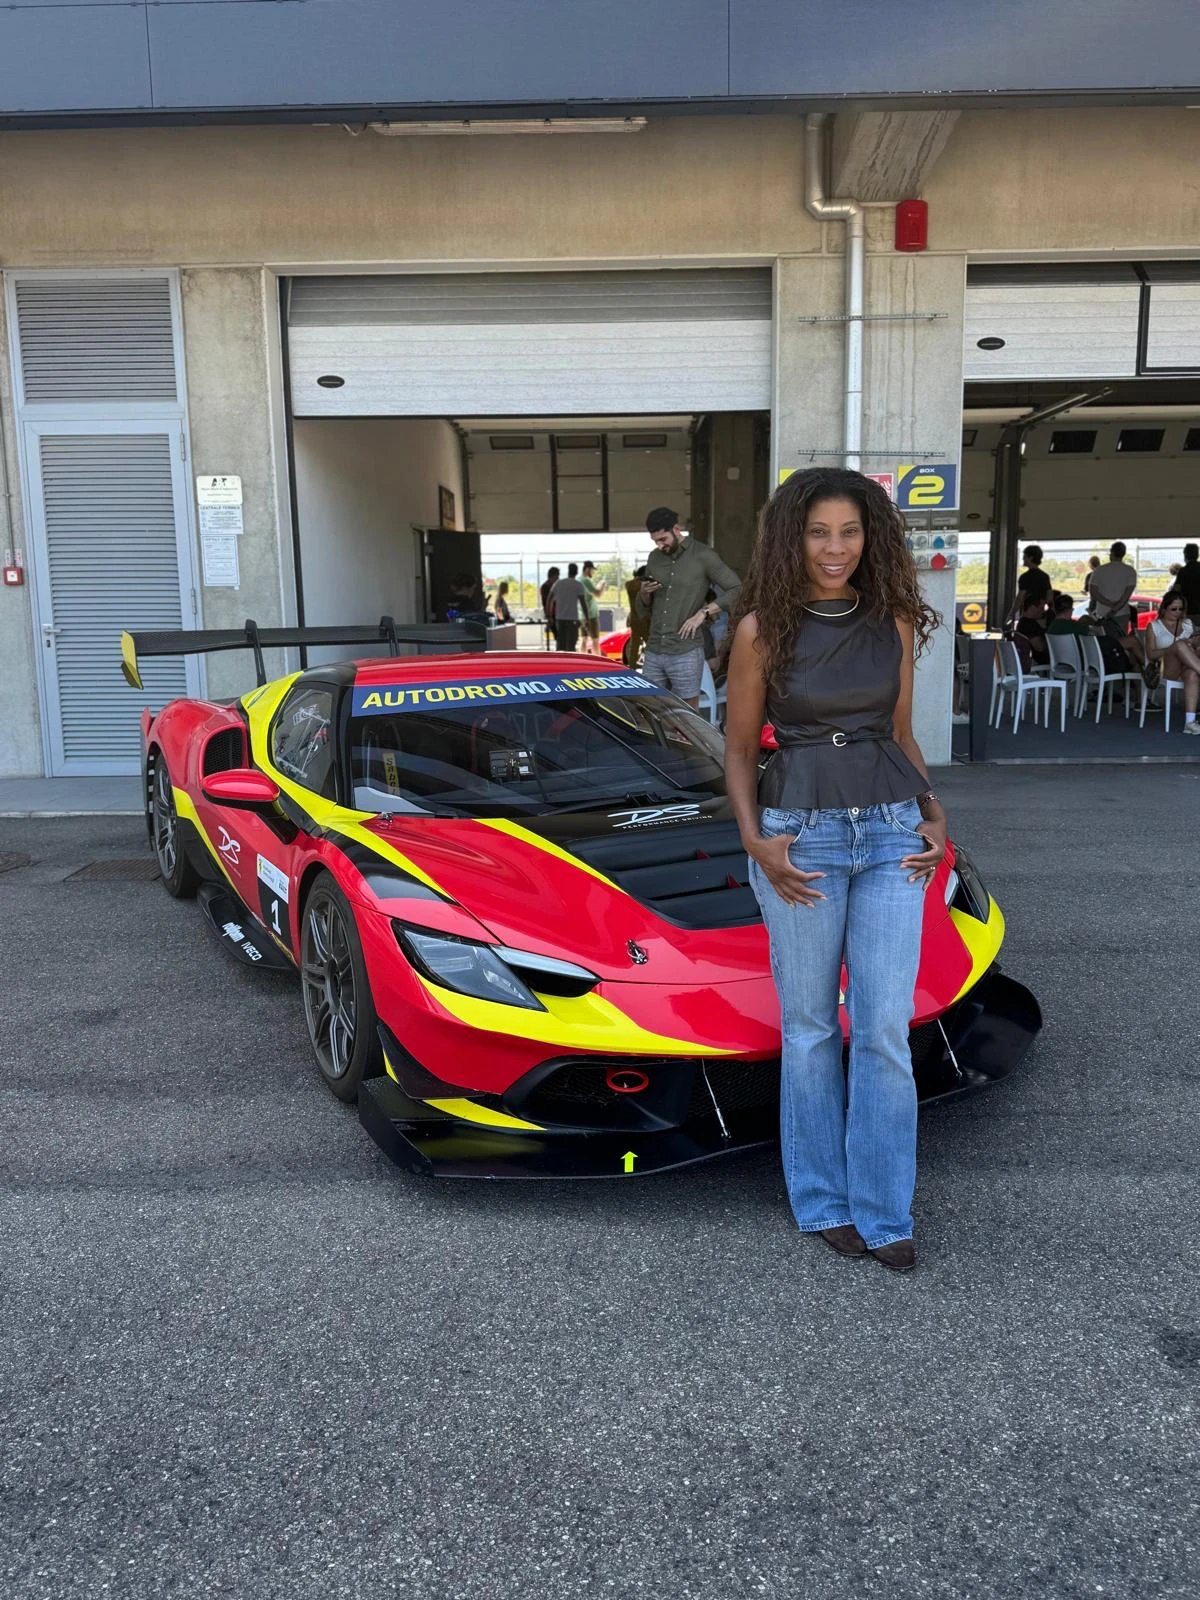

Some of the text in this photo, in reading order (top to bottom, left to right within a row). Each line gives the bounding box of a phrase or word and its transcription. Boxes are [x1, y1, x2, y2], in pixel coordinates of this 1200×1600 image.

[908, 475, 945, 506] 2
[361, 676, 659, 709] AUTODROMO di MODENA
[622, 819, 680, 829] PERFORMANCE
[271, 899, 282, 936] 1
[241, 941, 263, 961] IVECO
